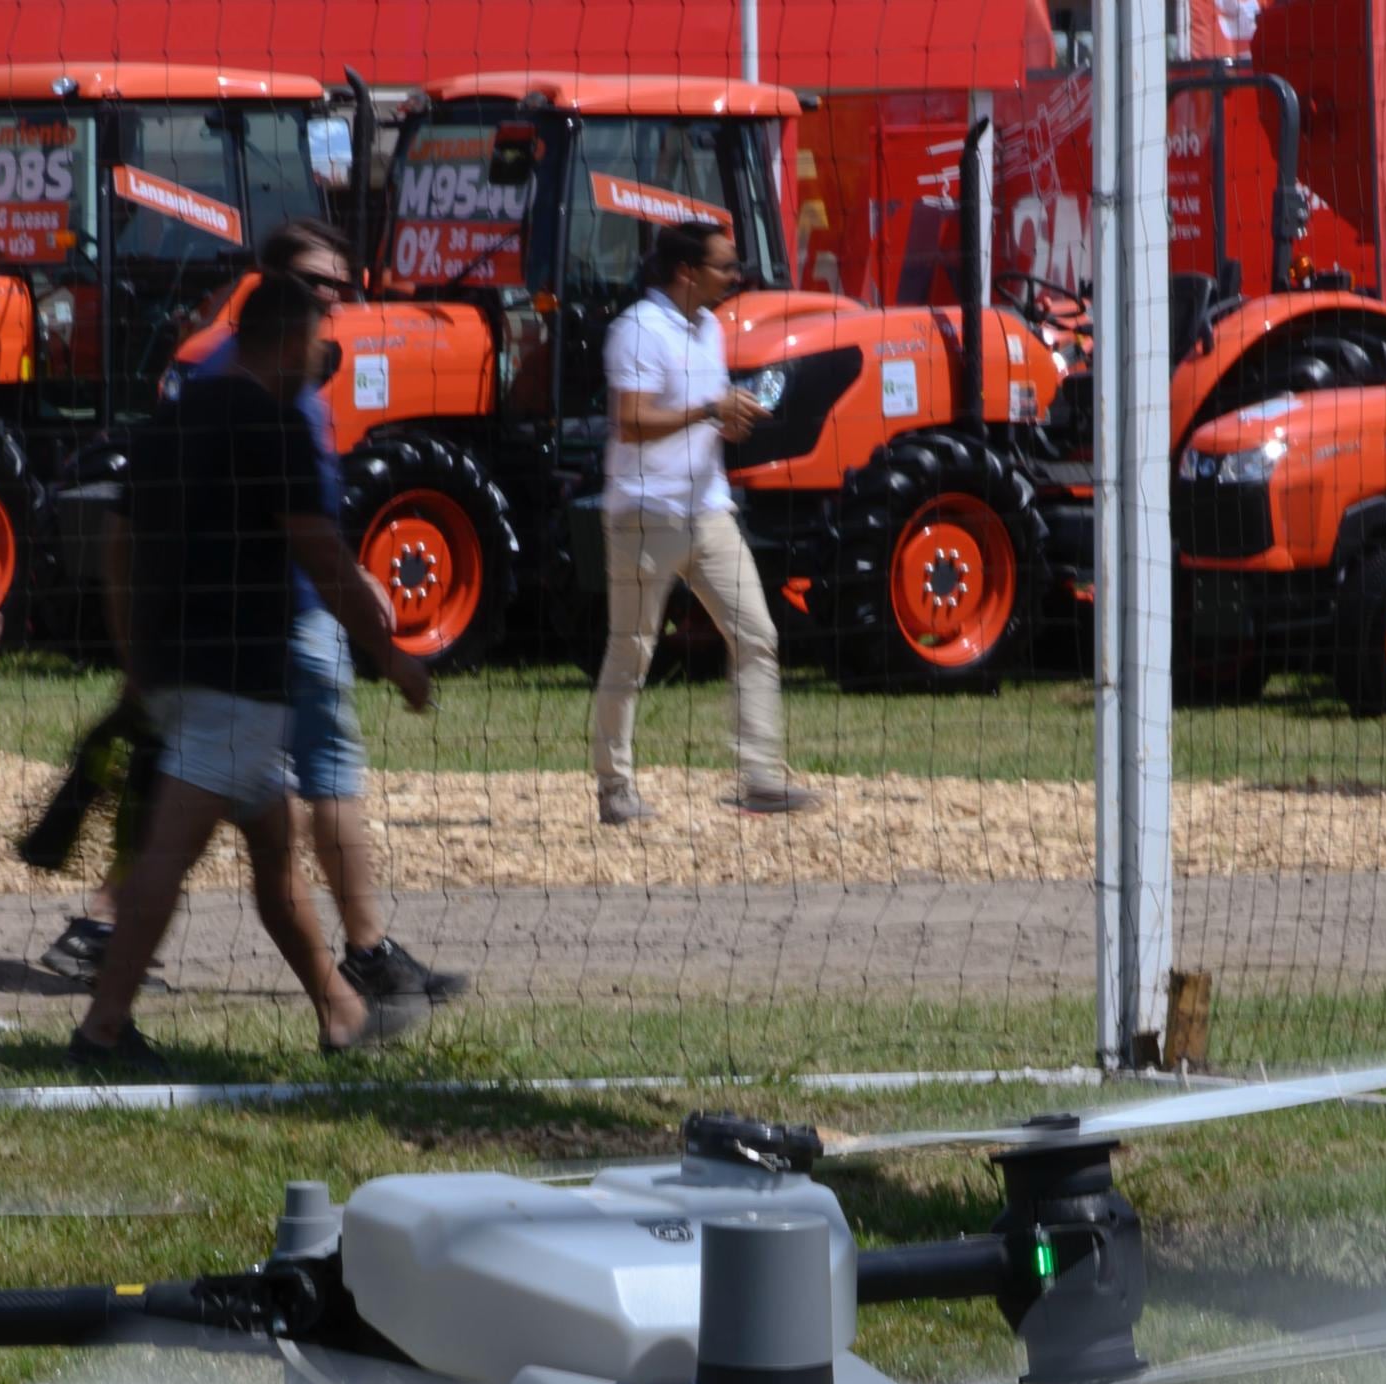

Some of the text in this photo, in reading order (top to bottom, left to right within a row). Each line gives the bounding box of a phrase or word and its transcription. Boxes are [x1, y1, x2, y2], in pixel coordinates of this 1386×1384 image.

[12, 211, 60, 231] meses
[128, 171, 229, 232] Lanzamiento
[396, 225, 442, 278] 0%
